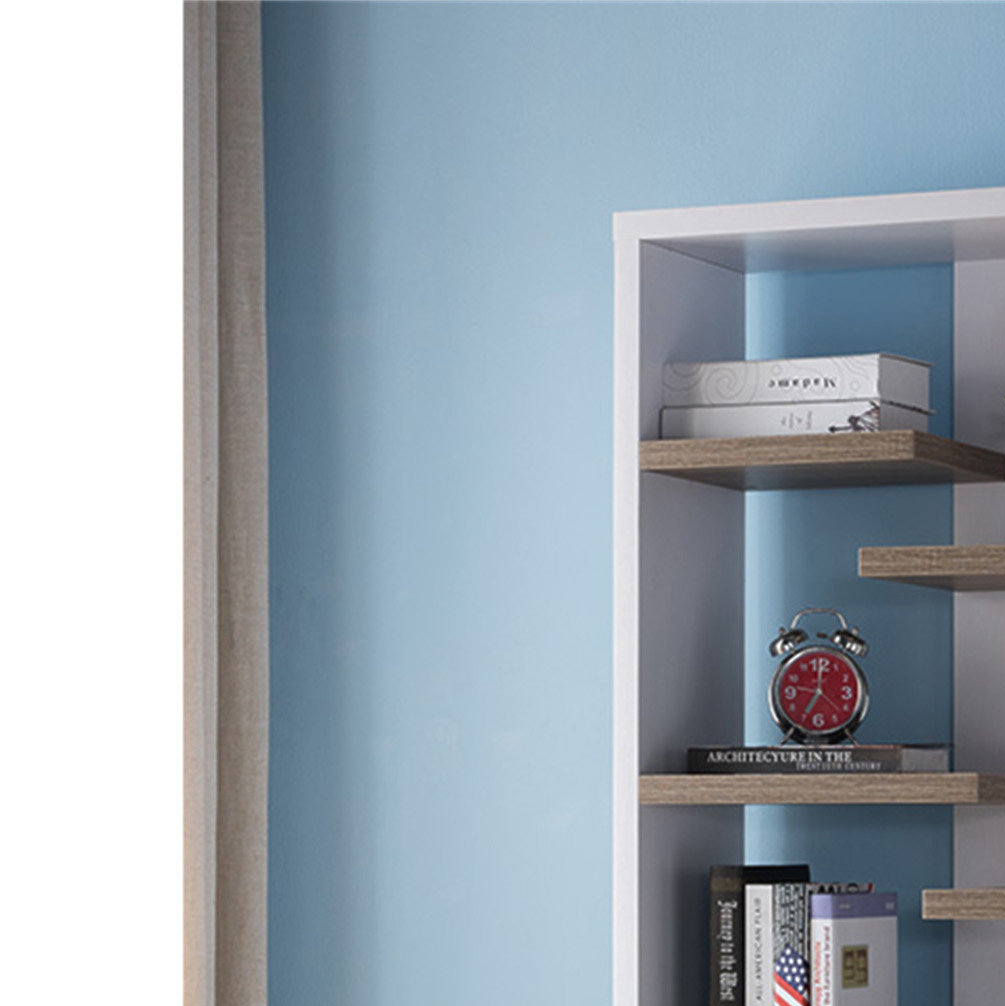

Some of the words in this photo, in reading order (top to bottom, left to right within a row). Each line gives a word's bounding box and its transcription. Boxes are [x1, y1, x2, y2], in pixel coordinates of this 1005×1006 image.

[767, 375, 837, 389] Madame
[809, 657, 830, 672] 12
[784, 686, 797, 700] 9
[841, 686, 853, 700] 3
[812, 713, 825, 727] 6
[807, 751, 823, 763] IN
[824, 751, 853, 763] THE
[823, 925, 831, 951] brand
[754, 928, 763, 980] AMERICAN
[754, 983, 763, 1001] ALL
